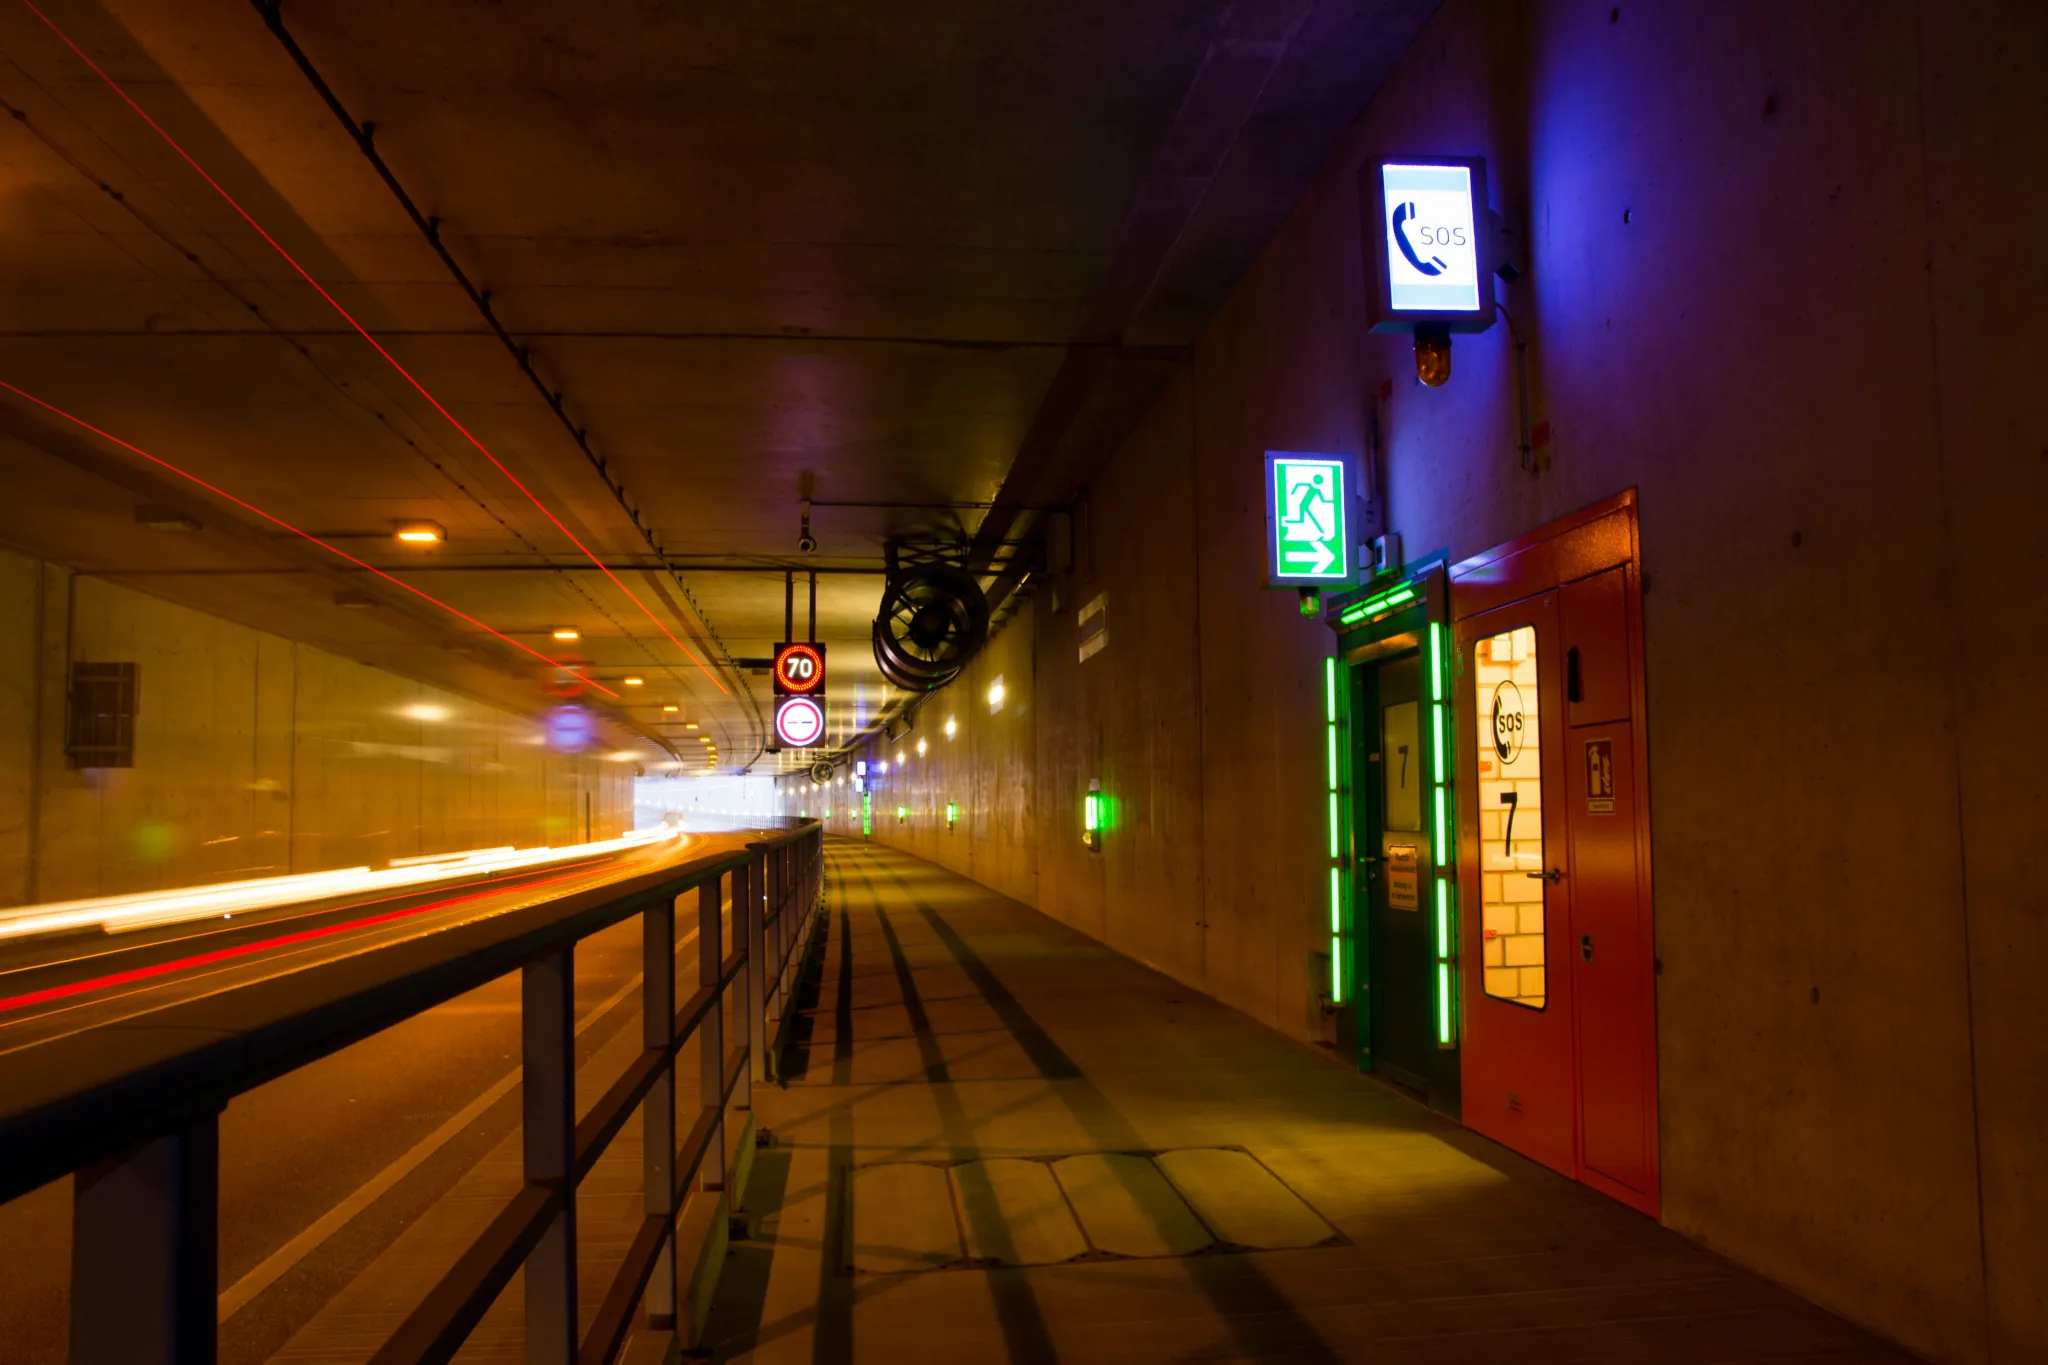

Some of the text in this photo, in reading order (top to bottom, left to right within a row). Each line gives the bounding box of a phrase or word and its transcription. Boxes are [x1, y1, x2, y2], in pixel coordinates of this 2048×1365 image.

[1420, 226, 1466, 246] SOS
[787, 658, 813, 678] 70
[1499, 712, 1523, 733] SOS
[1398, 745, 1408, 789] 7
[1500, 792, 1517, 857] 7
